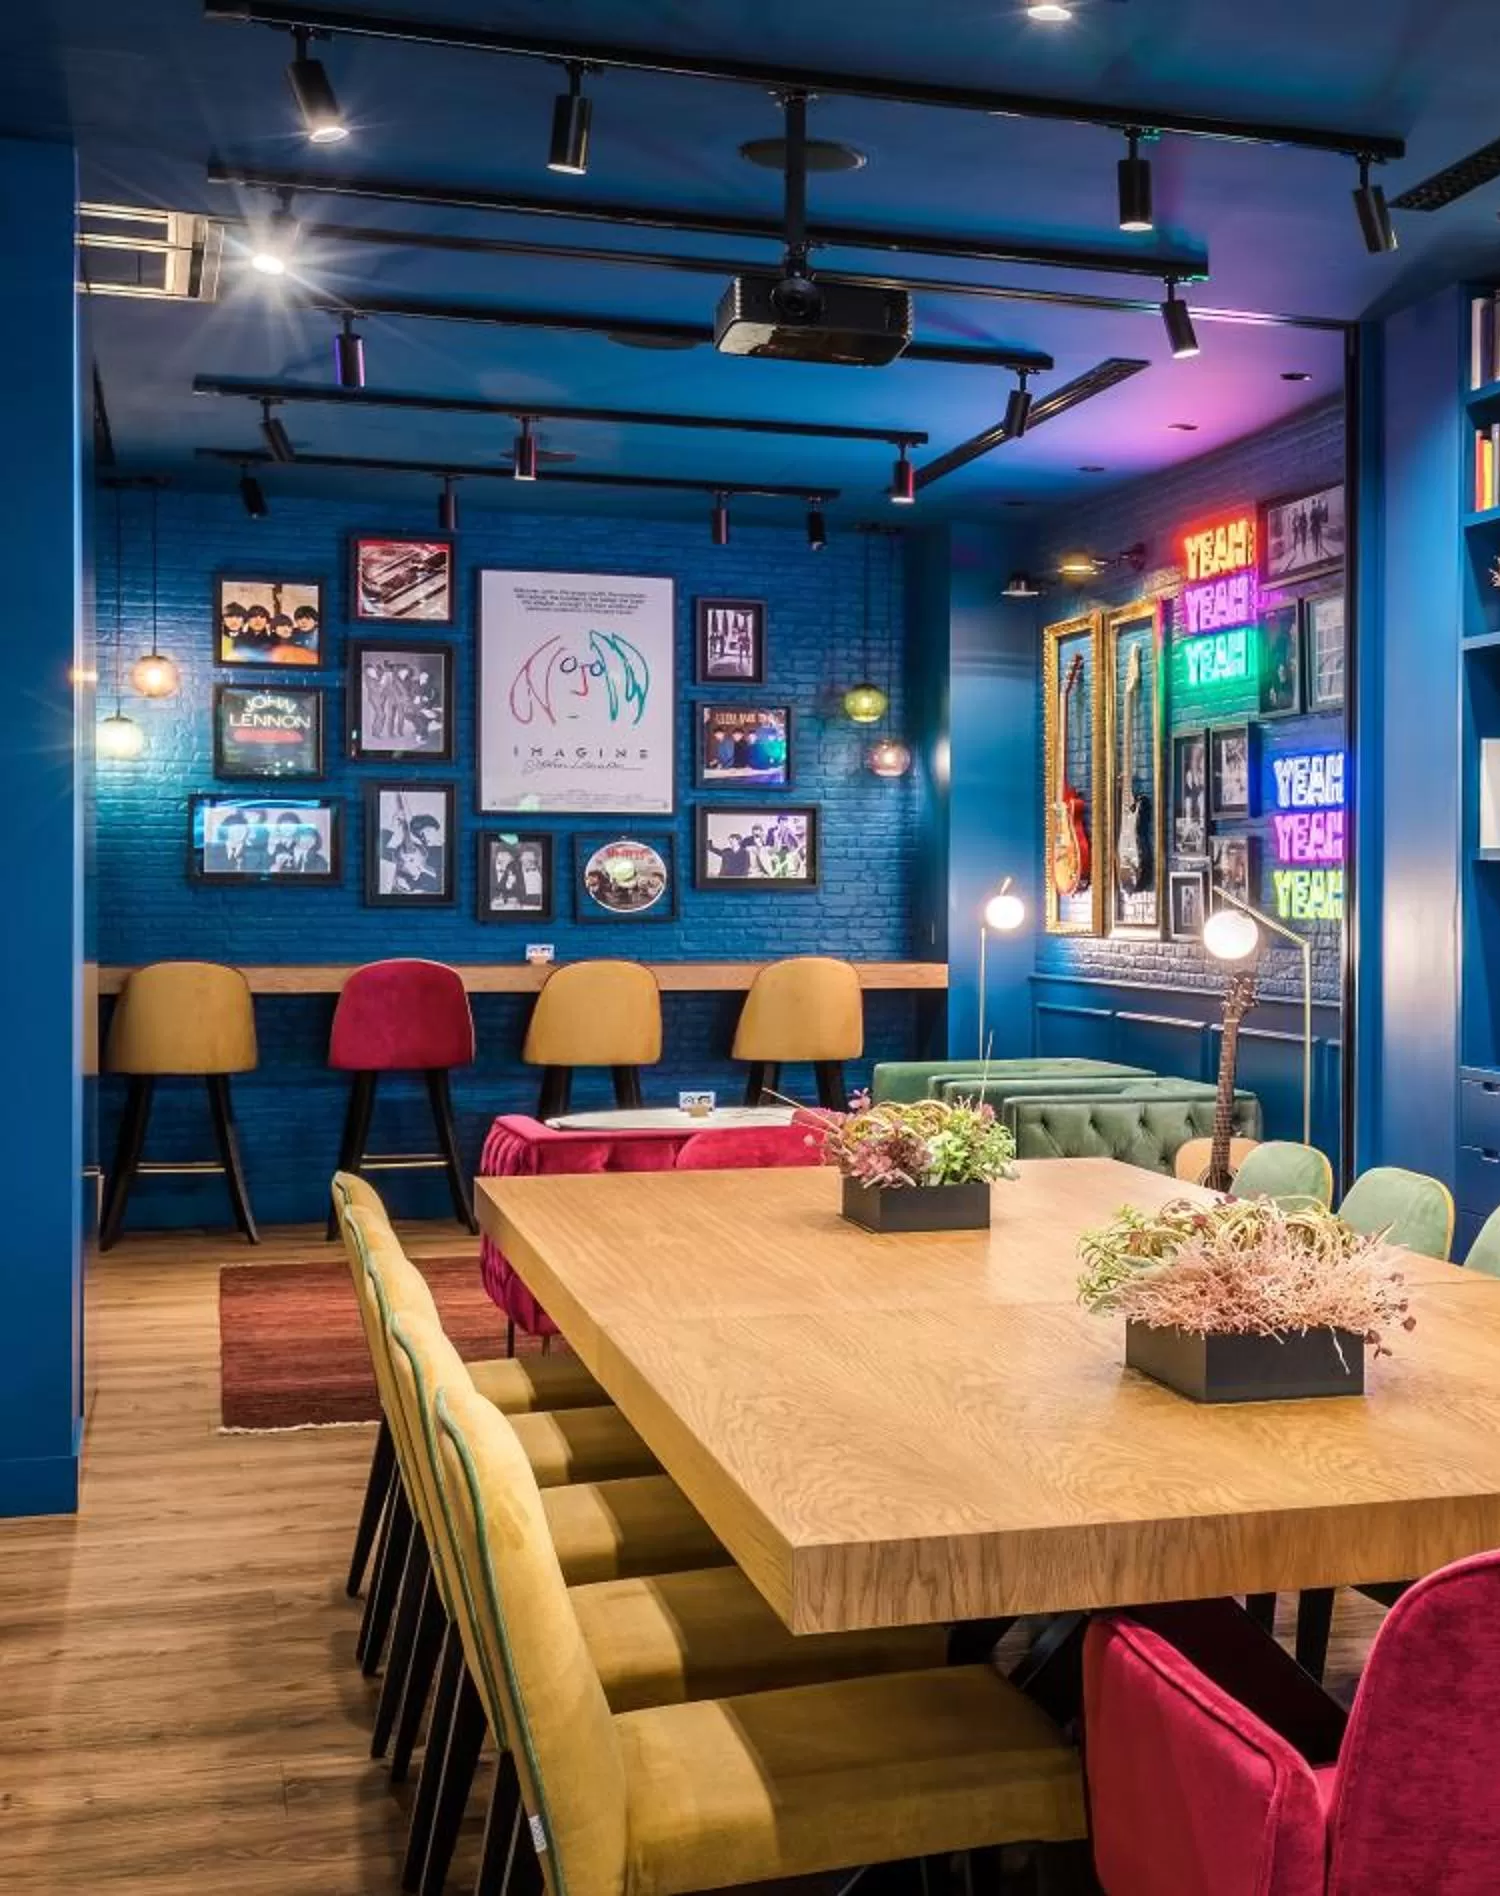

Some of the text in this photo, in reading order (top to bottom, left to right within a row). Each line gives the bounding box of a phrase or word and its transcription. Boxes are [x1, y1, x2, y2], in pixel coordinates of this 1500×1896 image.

[1184, 517, 1249, 579] YEAH
[1185, 575, 1249, 634] YEAH
[1185, 630, 1247, 685] YEAH
[229, 712, 311, 730] LENNON
[244, 694, 297, 713] JOHN
[513, 745, 648, 759] IMAGINE
[1273, 753, 1344, 808] YEAH
[1273, 811, 1344, 861] YEAH
[1272, 869, 1344, 919] YEAH
